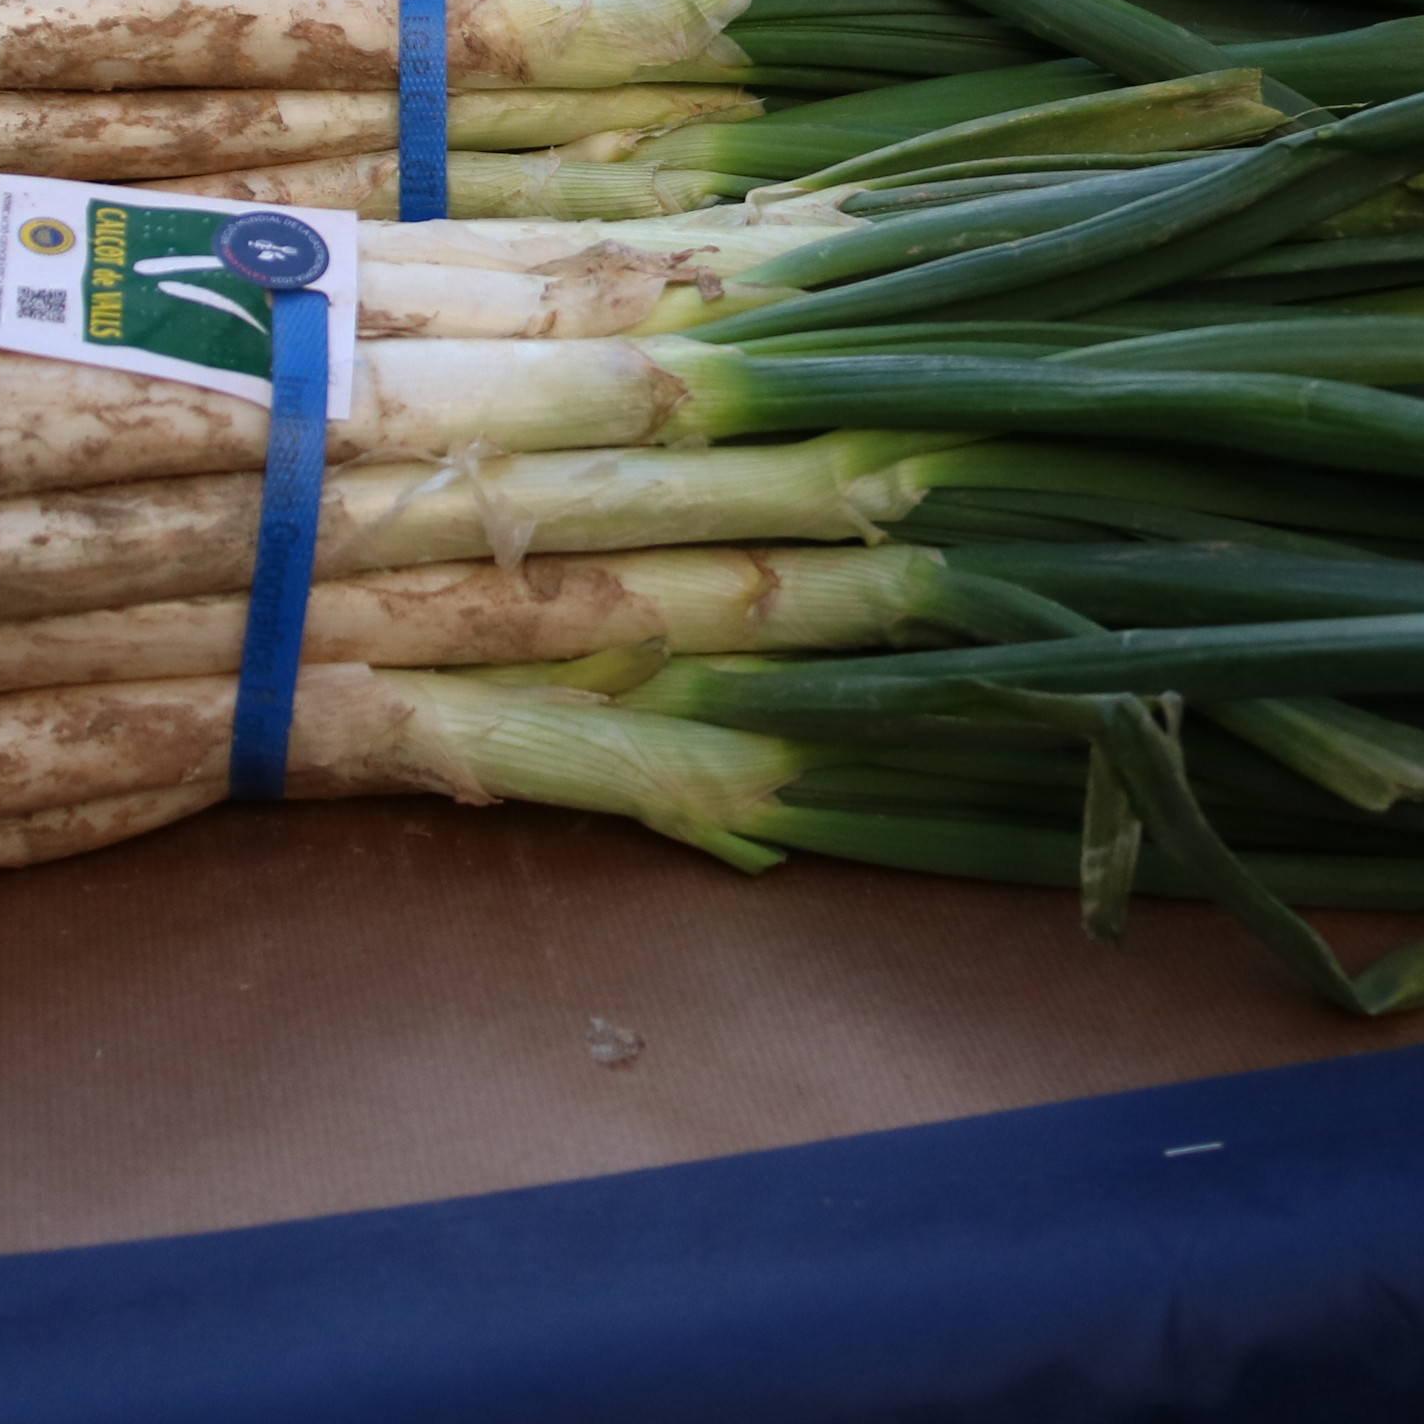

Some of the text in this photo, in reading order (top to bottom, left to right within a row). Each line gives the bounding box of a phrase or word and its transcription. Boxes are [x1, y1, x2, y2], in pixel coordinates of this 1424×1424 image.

[87, 207, 128, 338] CALÇOT de VALLS
